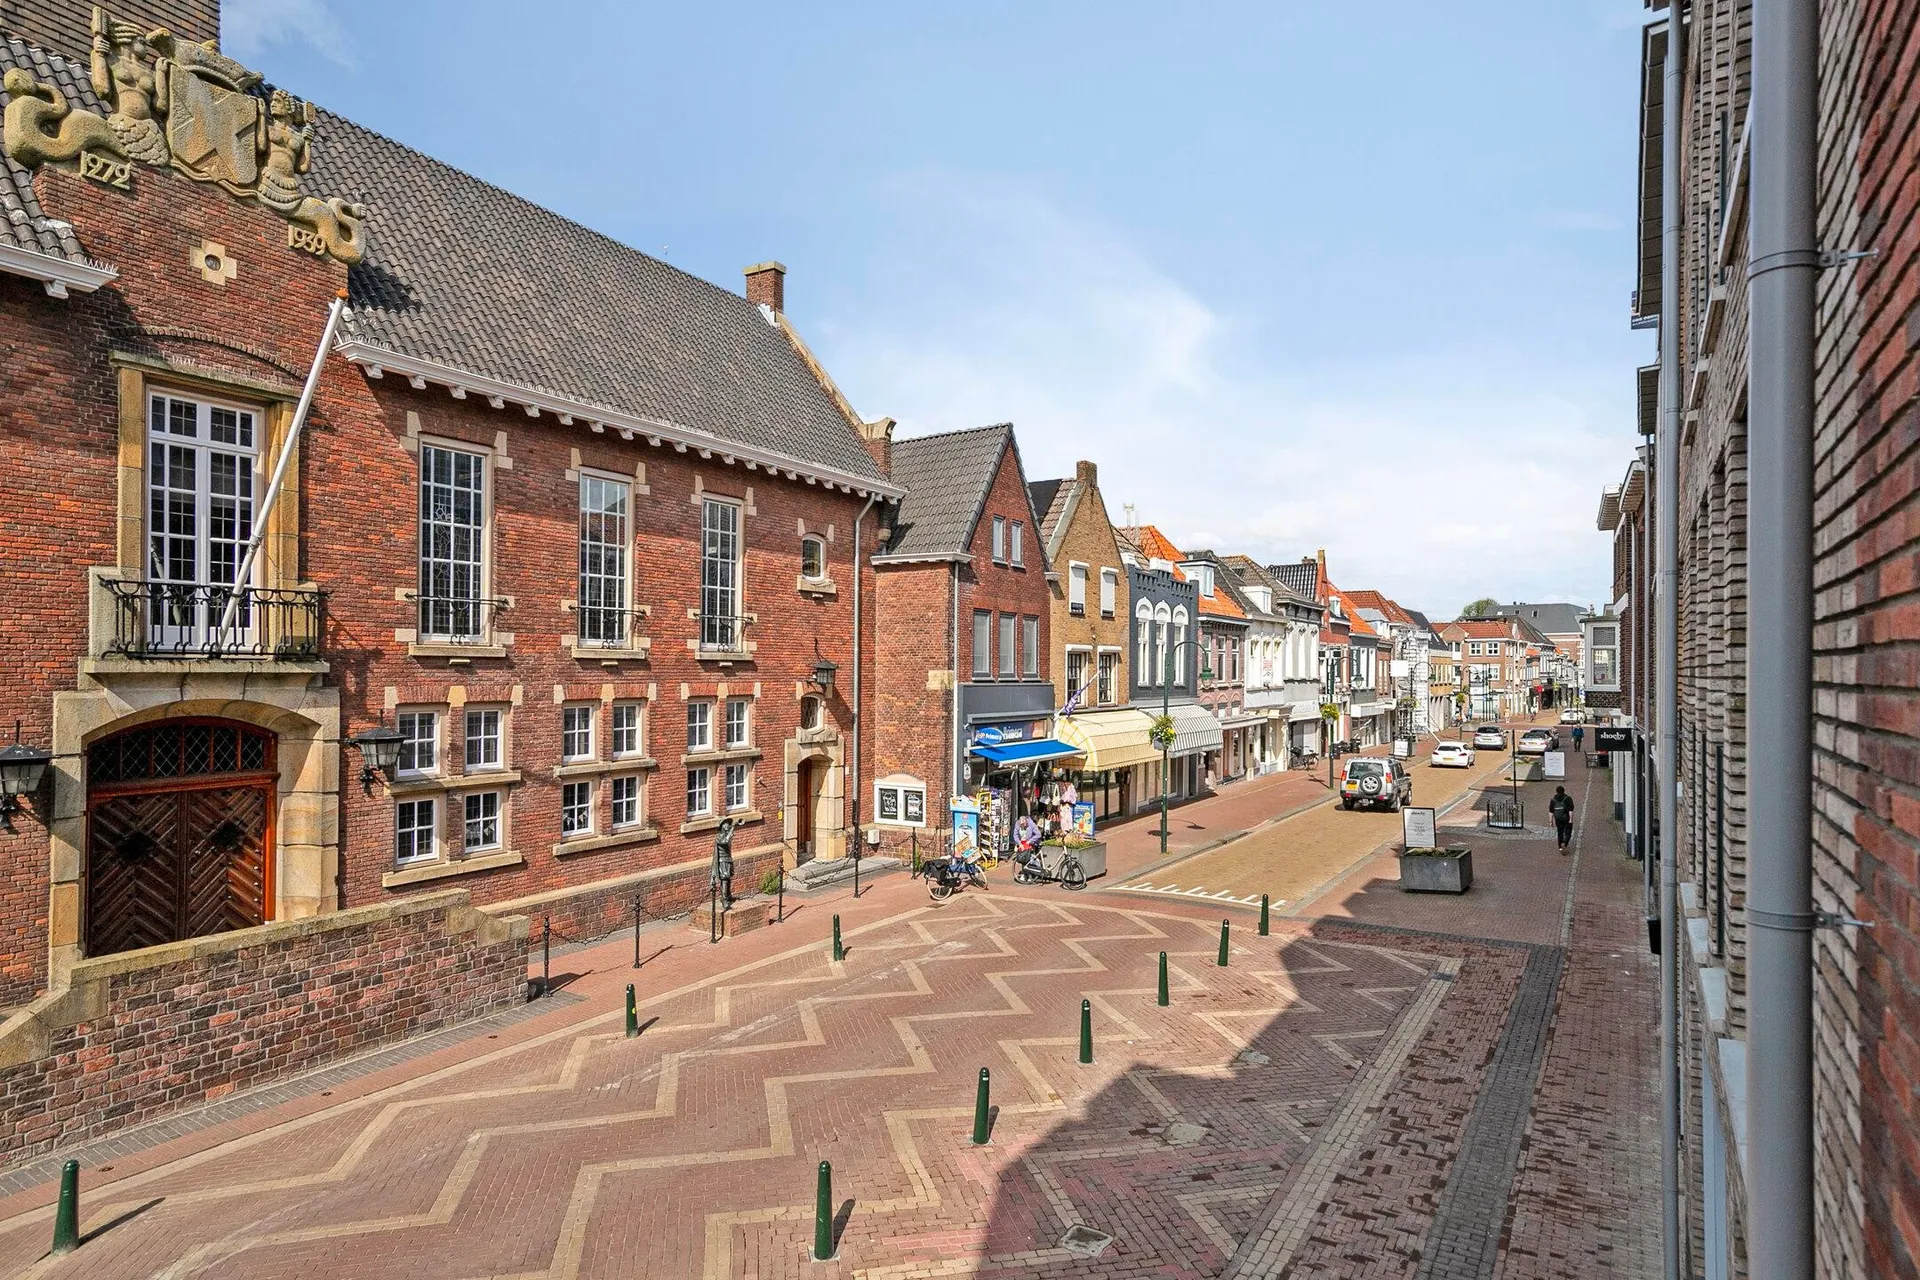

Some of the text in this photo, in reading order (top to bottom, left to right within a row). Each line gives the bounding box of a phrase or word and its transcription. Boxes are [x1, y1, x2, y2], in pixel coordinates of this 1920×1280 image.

[80, 150, 131, 190] 1272
[288, 224, 326, 255] 1939
[985, 732, 1002, 740] Primera
[1600, 731, 1626, 740] shoeby
